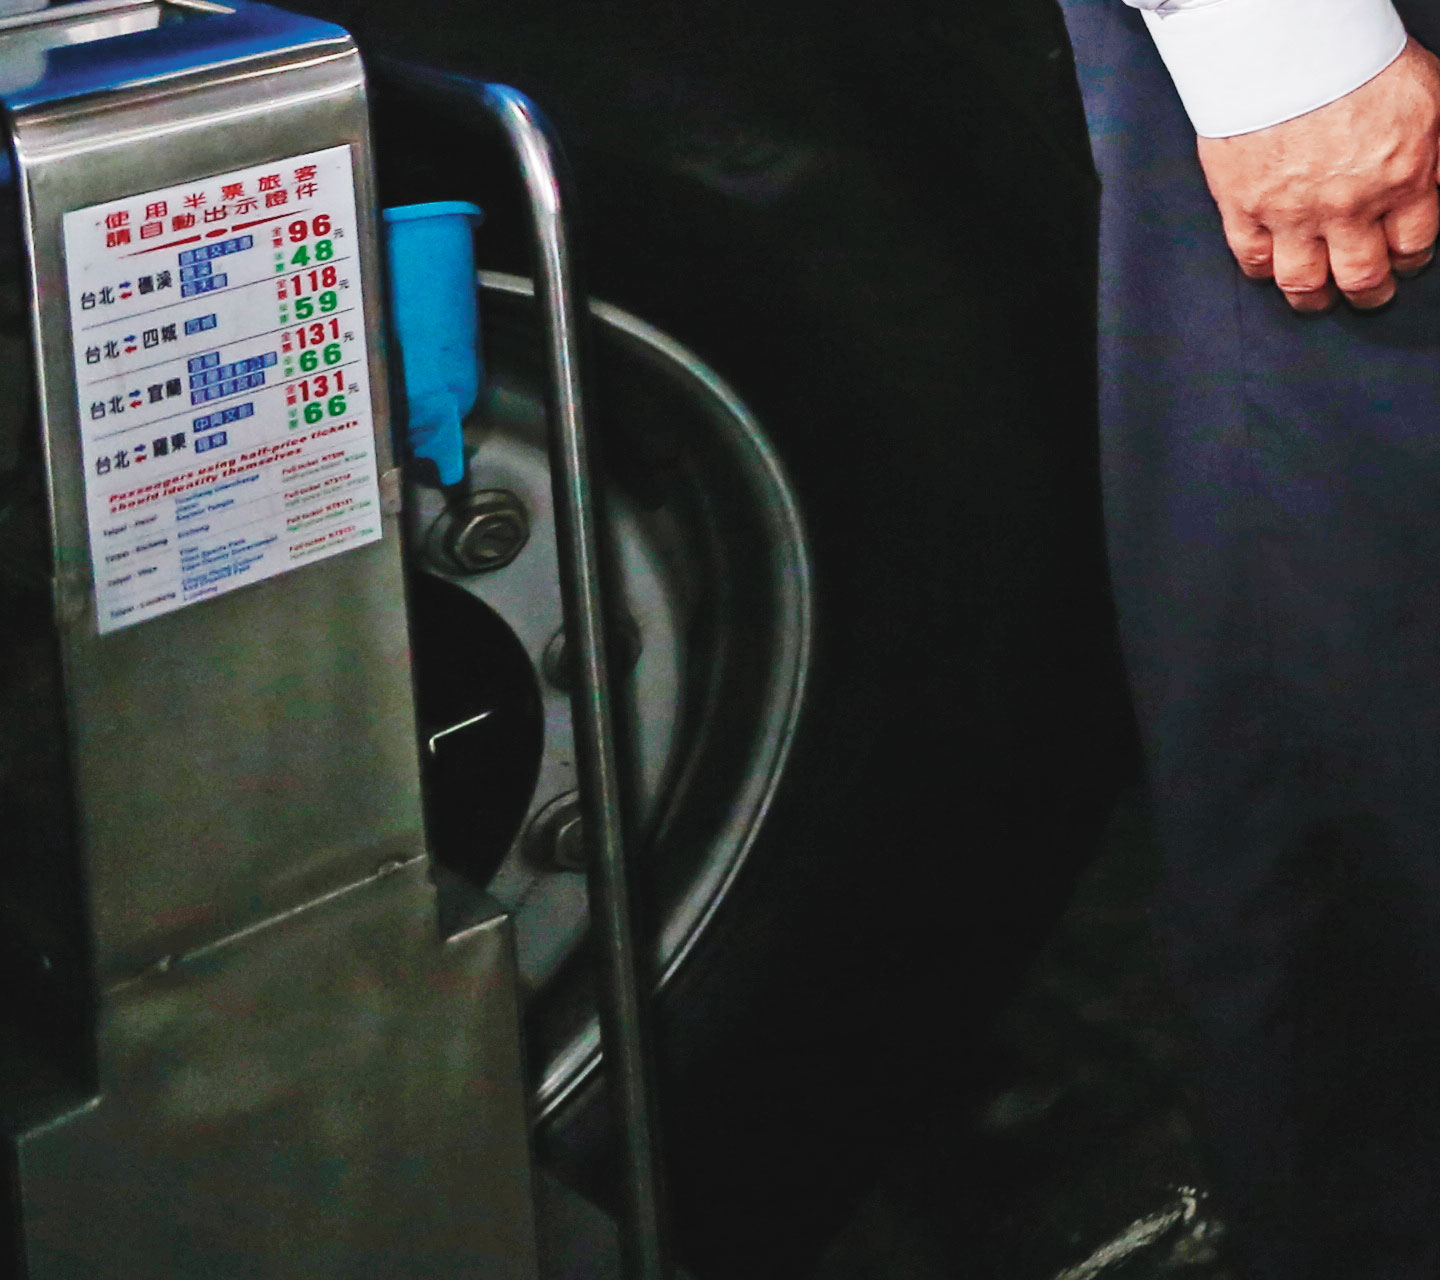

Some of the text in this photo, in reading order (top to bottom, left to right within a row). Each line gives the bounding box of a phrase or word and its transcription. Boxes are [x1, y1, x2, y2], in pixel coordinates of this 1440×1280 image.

[105, 164, 316, 229] 使用半票旅客
[106, 182, 318, 248] 請自動出示證件
[287, 213, 331, 243] 96
[291, 238, 333, 268] 48
[292, 265, 336, 296] 118
[81, 286, 114, 309] 台北
[295, 289, 337, 320] 59
[296, 318, 340, 349] 131
[86, 340, 118, 364] 台北
[299, 342, 341, 372] 66
[300, 370, 344, 402] 131
[91, 396, 123, 420] 台北
[304, 394, 345, 425] 66
[96, 450, 128, 475] 台北
